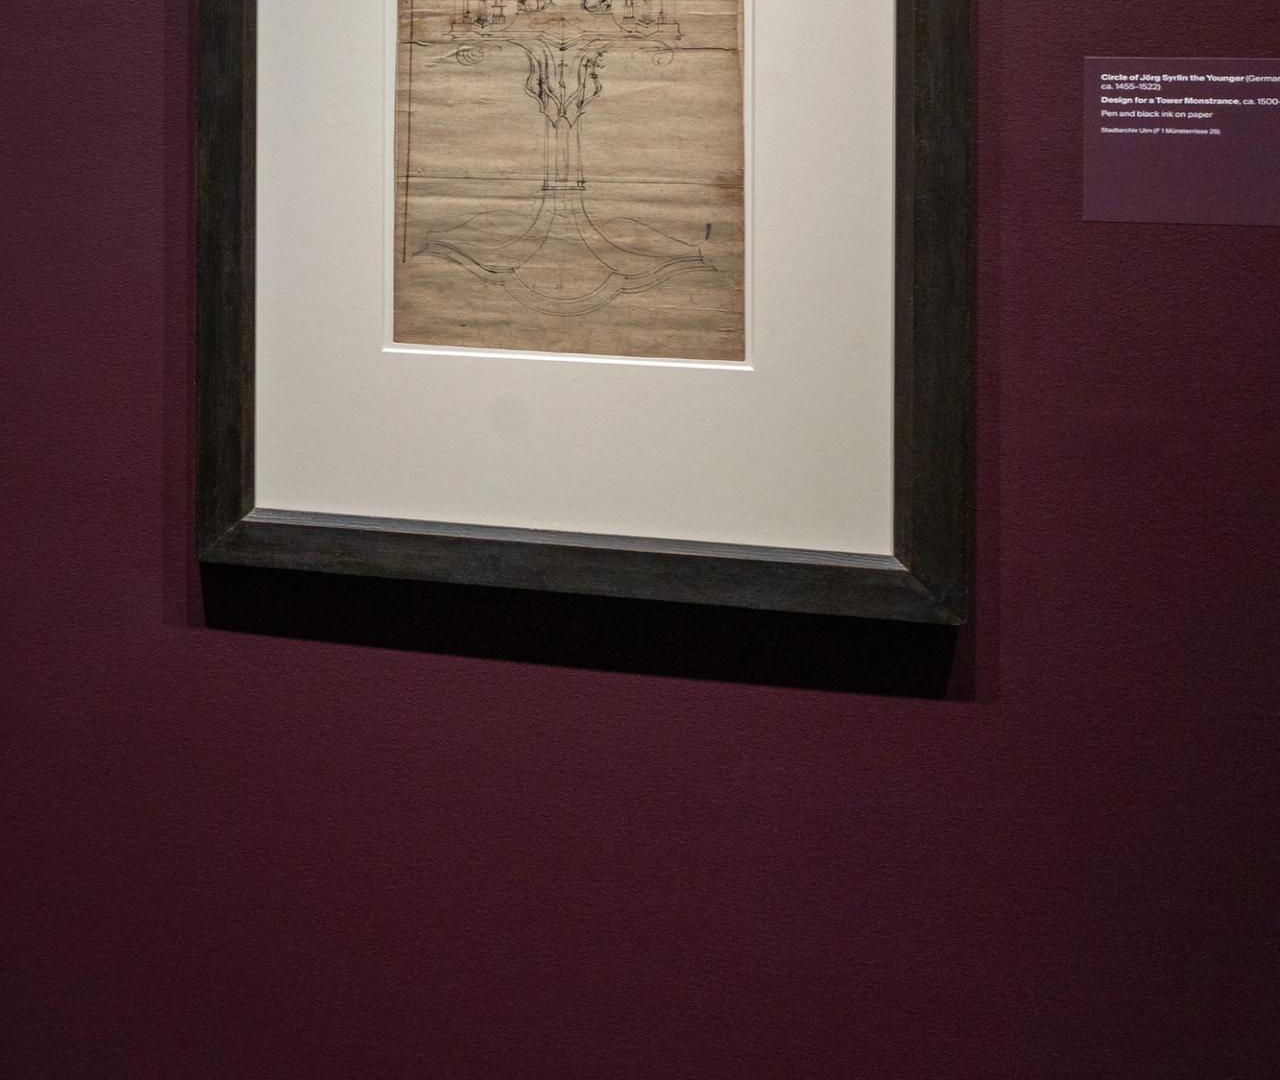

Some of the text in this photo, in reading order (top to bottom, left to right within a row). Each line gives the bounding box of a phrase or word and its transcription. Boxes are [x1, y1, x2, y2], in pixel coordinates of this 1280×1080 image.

[1101, 73, 1128, 81] Circle
[1140, 74, 1161, 83] Jörg
[1162, 74, 1188, 82] Syrlin
[1206, 74, 1244, 83] Younger
[1101, 96, 1133, 105] Design
[1134, 96, 1147, 104] for
[1184, 97, 1242, 105] Monstrance,
[1101, 109, 1118, 117] Pen
[1137, 110, 1160, 118] black
[1161, 110, 1173, 118] ink
